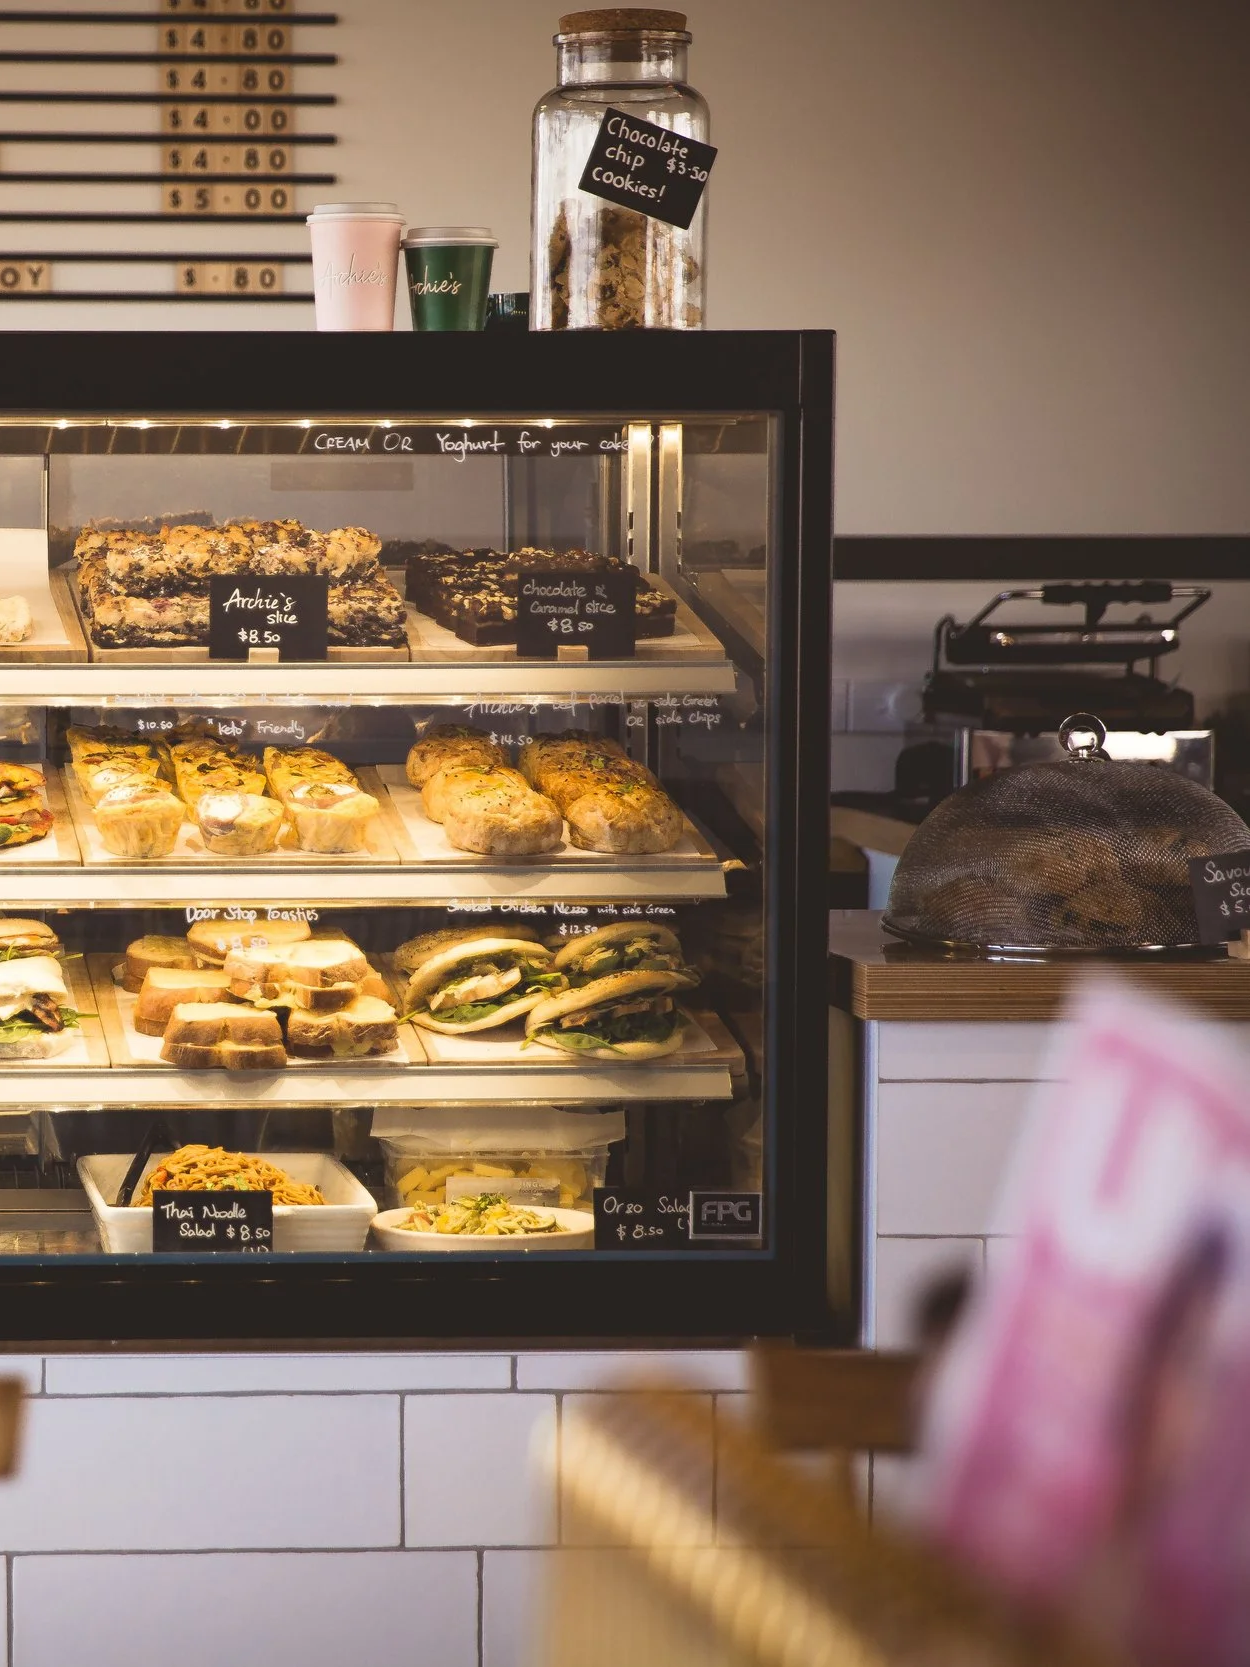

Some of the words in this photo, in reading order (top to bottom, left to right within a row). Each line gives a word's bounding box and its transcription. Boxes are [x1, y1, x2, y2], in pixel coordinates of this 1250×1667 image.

[607, 116, 689, 159] Chocolate
[605, 143, 645, 171] chip
[592, 167, 667, 203] cookies!
[516, 430, 542, 450] for
[550, 438, 589, 457] your
[222, 587, 297, 613] Archie's
[237, 627, 282, 644] $8.50
[655, 710, 683, 727] side
[185, 905, 221, 923] Door
[223, 904, 258, 926] Stop
[160, 1201, 195, 1219] Thai
[202, 1202, 247, 1219] Noodle
[701, 1200, 752, 1221] FPG
[179, 1222, 216, 1238] Salad
